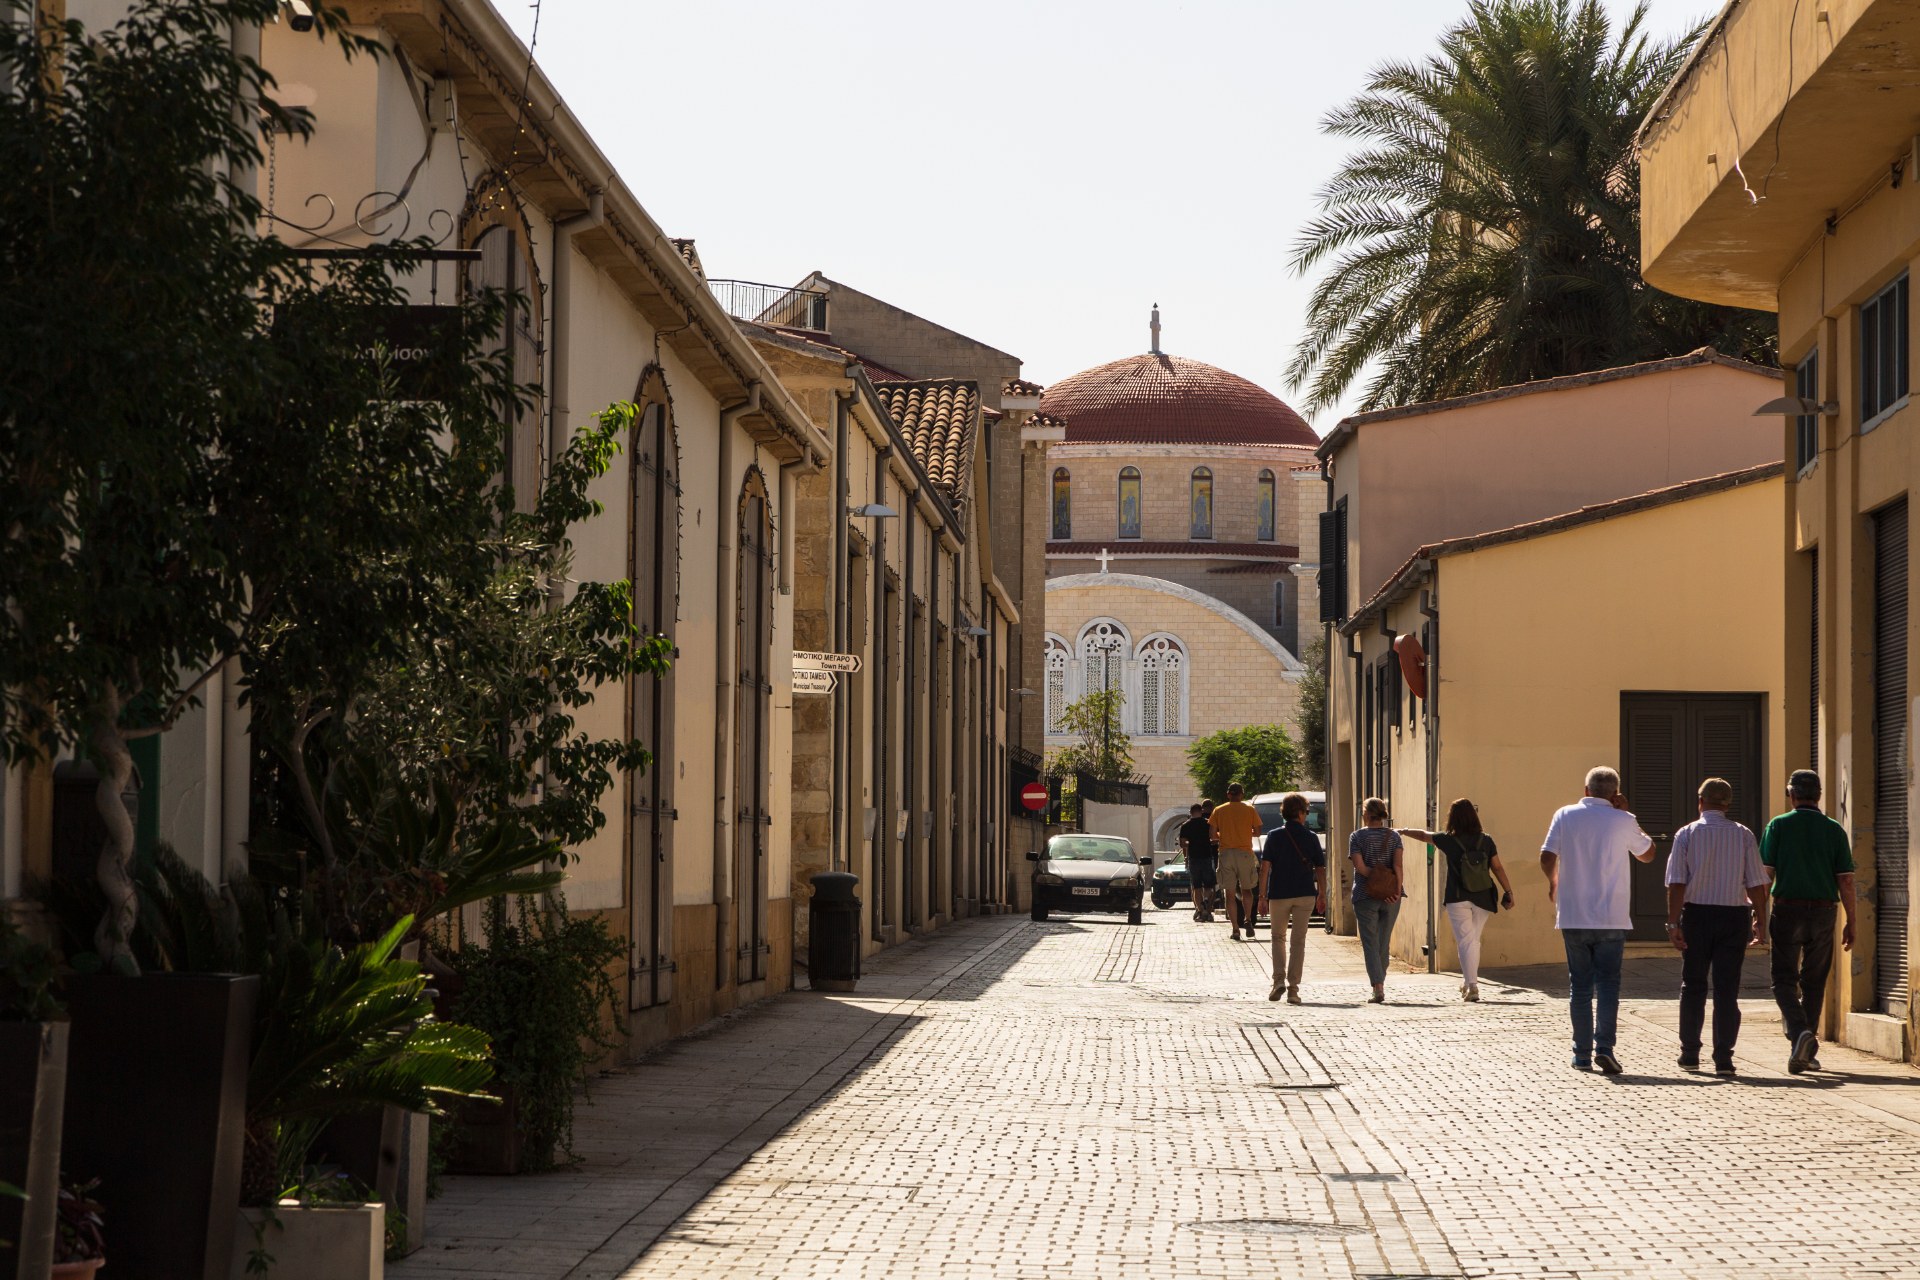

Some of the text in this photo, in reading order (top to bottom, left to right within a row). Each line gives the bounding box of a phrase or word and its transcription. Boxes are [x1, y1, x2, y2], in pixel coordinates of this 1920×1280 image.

[824, 654, 850, 662] ΜΕΓΑΡΟ
[821, 661, 850, 670] Town Hall
[810, 671, 827, 681] ΤΑΜΕΙΟ
